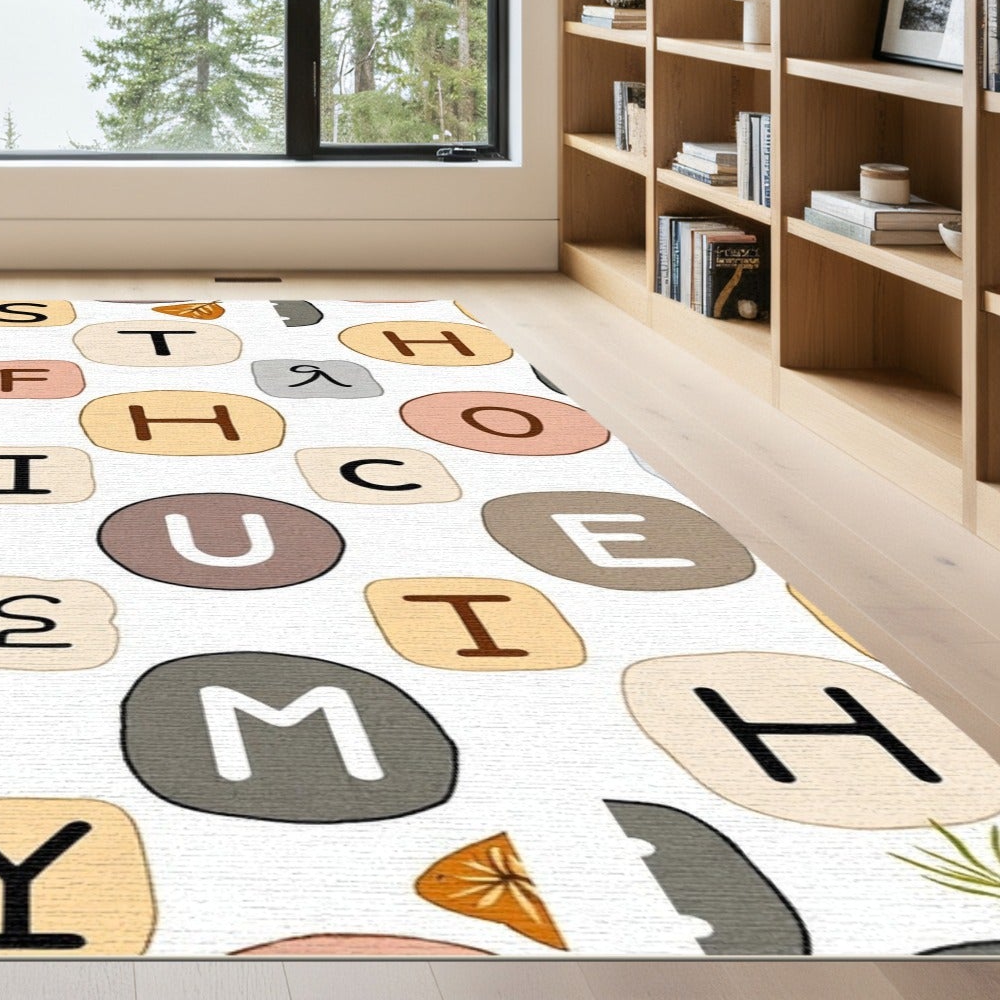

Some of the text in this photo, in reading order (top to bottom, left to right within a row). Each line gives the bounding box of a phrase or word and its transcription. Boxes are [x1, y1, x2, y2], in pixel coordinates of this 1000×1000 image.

[117, 330, 196, 356] T
[382, 330, 475, 357] H
[0, 369, 50, 392] F
[129, 405, 240, 441] H
[461, 407, 543, 438] O
[340, 459, 421, 491] C
[165, 514, 274, 567] U
[551, 514, 695, 567] E
[403, 595, 529, 657] I
[200, 686, 385, 782] M
[694, 687, 942, 784] H
